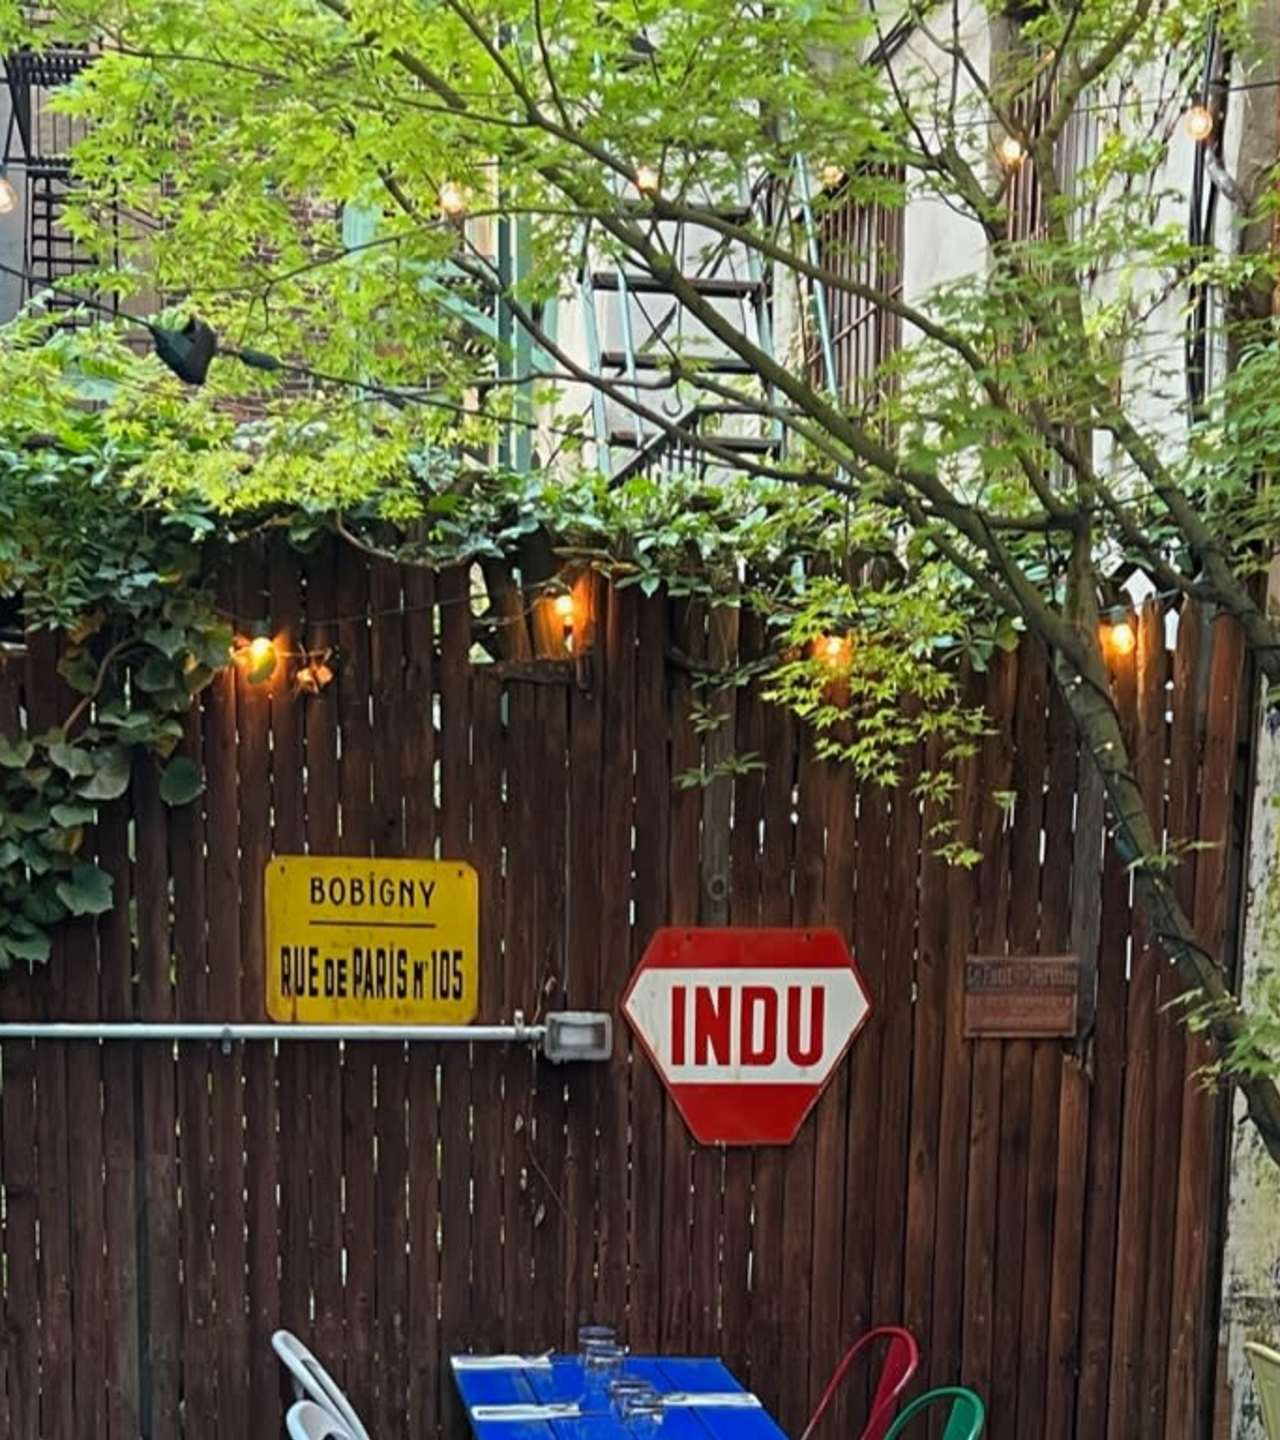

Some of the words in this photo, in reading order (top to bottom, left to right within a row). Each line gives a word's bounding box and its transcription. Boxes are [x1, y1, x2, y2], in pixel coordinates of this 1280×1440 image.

[310, 871, 435, 908] BOBIGNY
[281, 947, 318, 997] RUE
[325, 959, 347, 998] DE
[353, 941, 407, 1000] PARIS
[672, 986, 825, 1066] INDU
